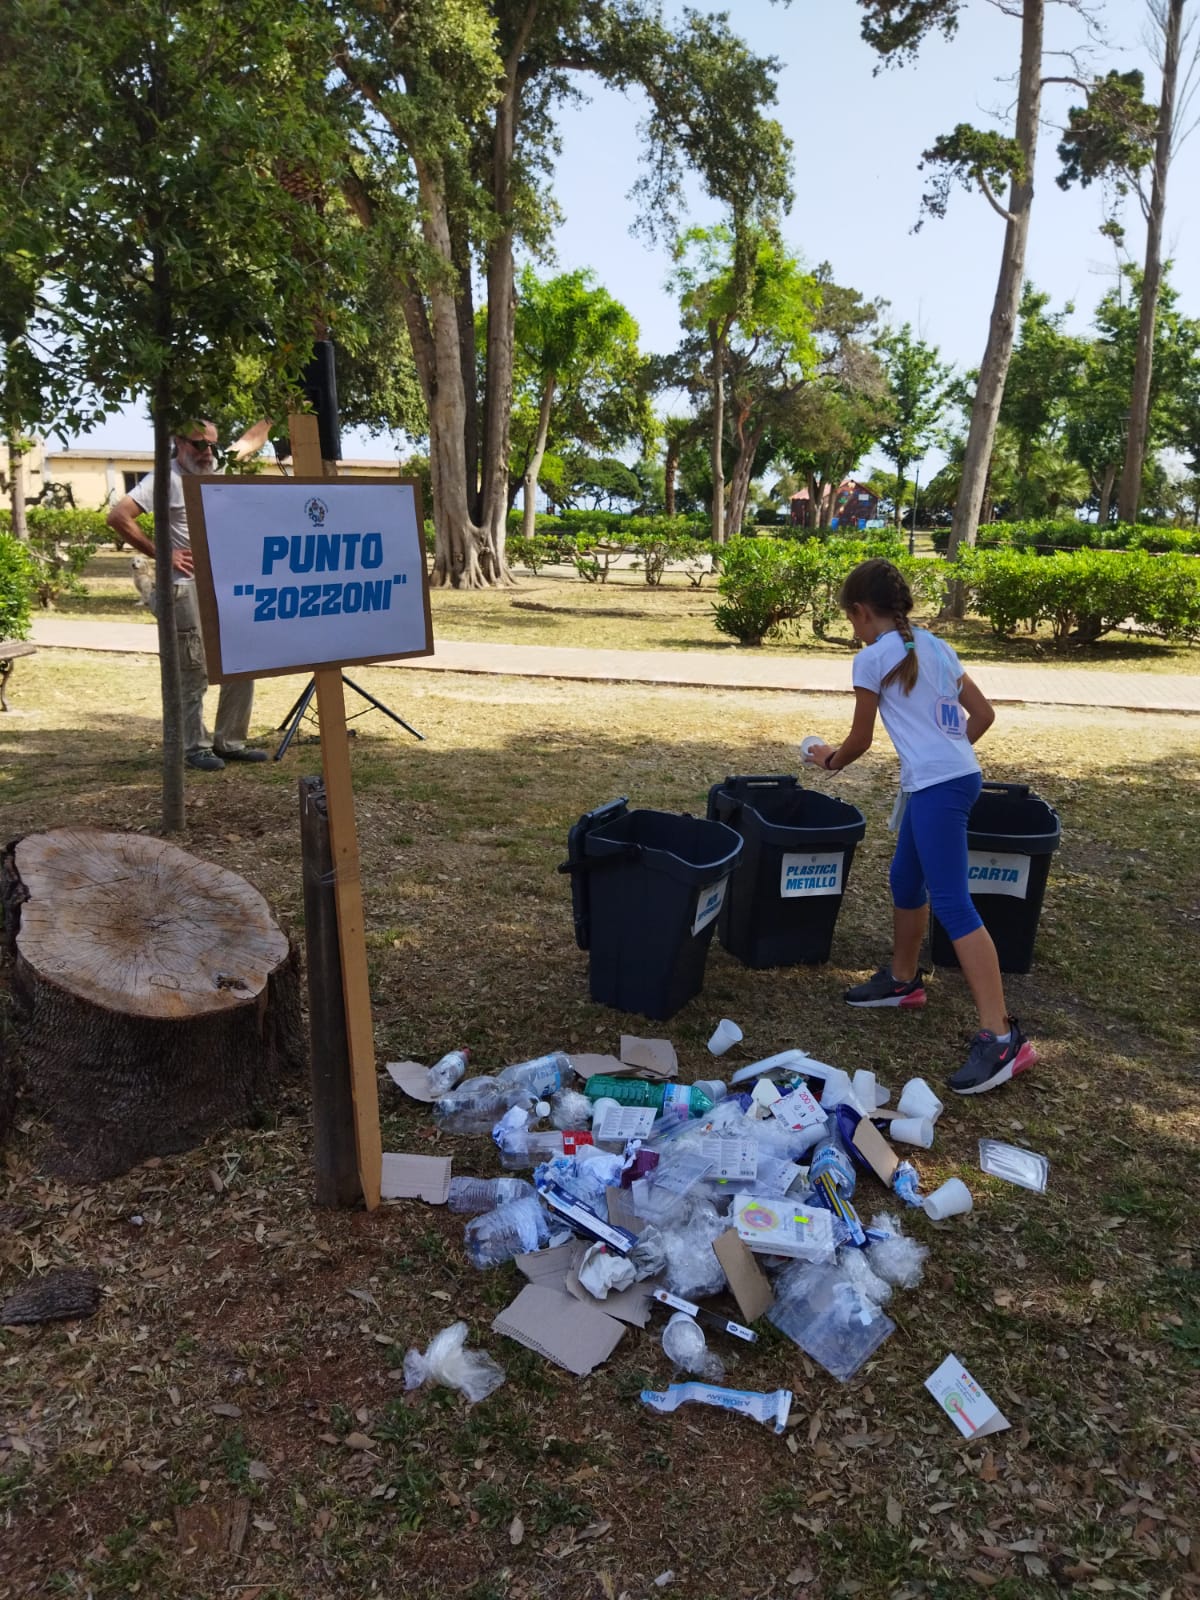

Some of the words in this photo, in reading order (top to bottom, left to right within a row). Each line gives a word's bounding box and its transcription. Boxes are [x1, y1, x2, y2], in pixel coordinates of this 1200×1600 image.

[261, 532, 384, 576] PUNTO
[233, 574, 407, 622] "ZOZZONI"
[941, 703, 960, 728] M
[786, 863, 838, 877] PLASTICA
[967, 866, 1019, 883] CARTA
[785, 876, 837, 890] METALLO
